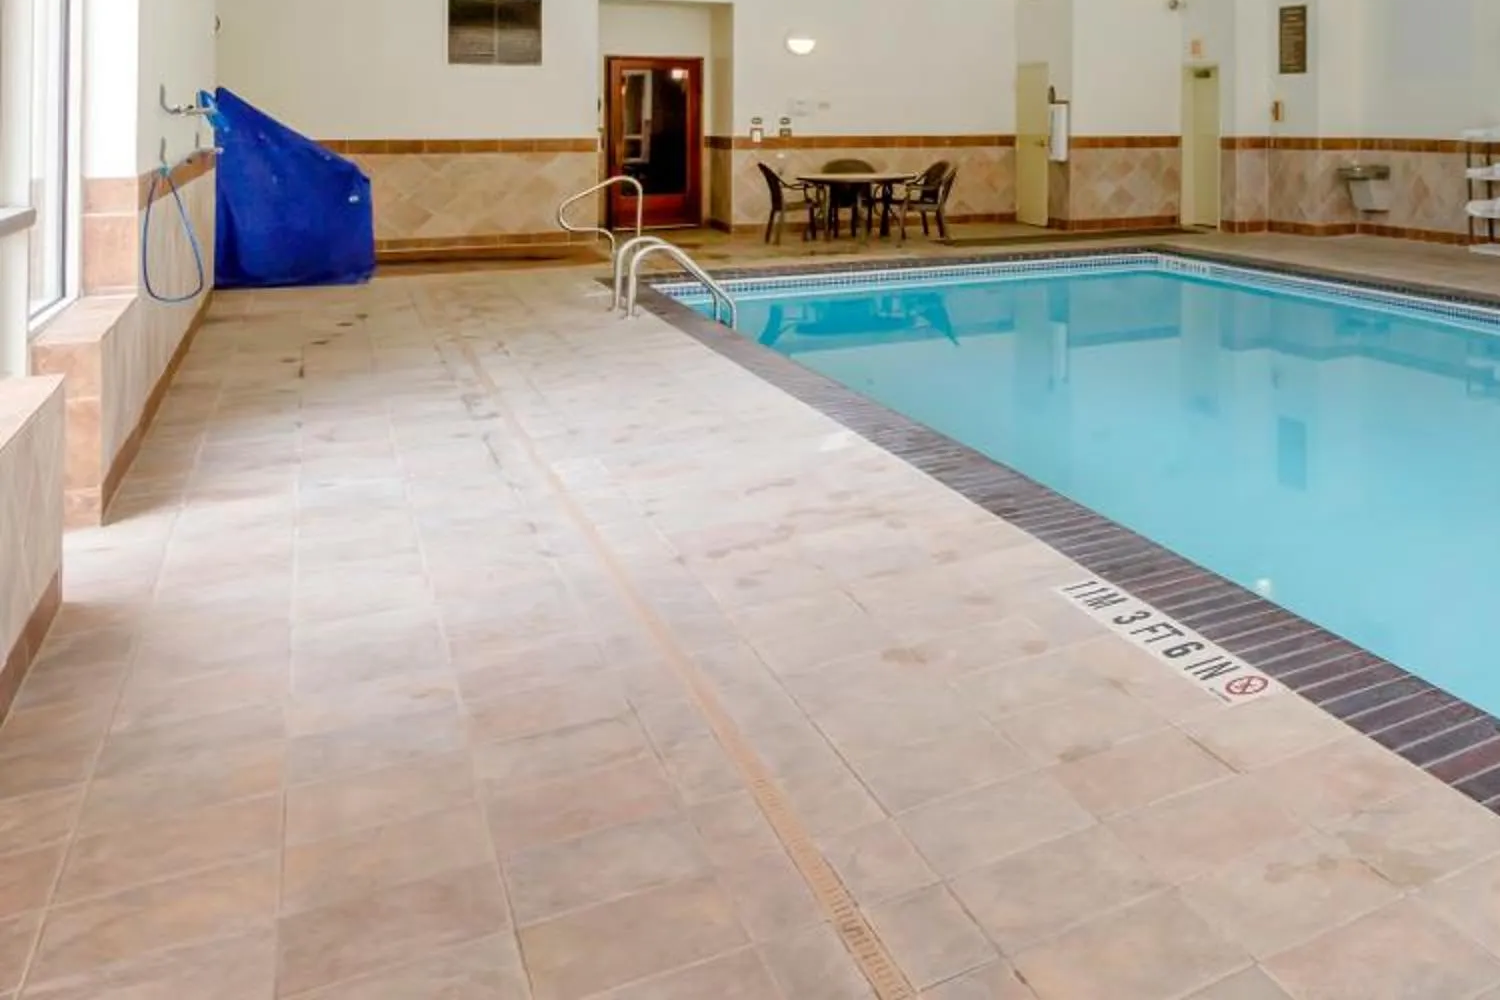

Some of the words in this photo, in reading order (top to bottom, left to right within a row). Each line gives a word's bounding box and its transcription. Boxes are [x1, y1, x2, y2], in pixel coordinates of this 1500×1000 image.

[1112, 610, 1152, 625] 3
[1129, 621, 1185, 643] FT
[1162, 641, 1205, 659] 6
[1184, 655, 1240, 681] IN
